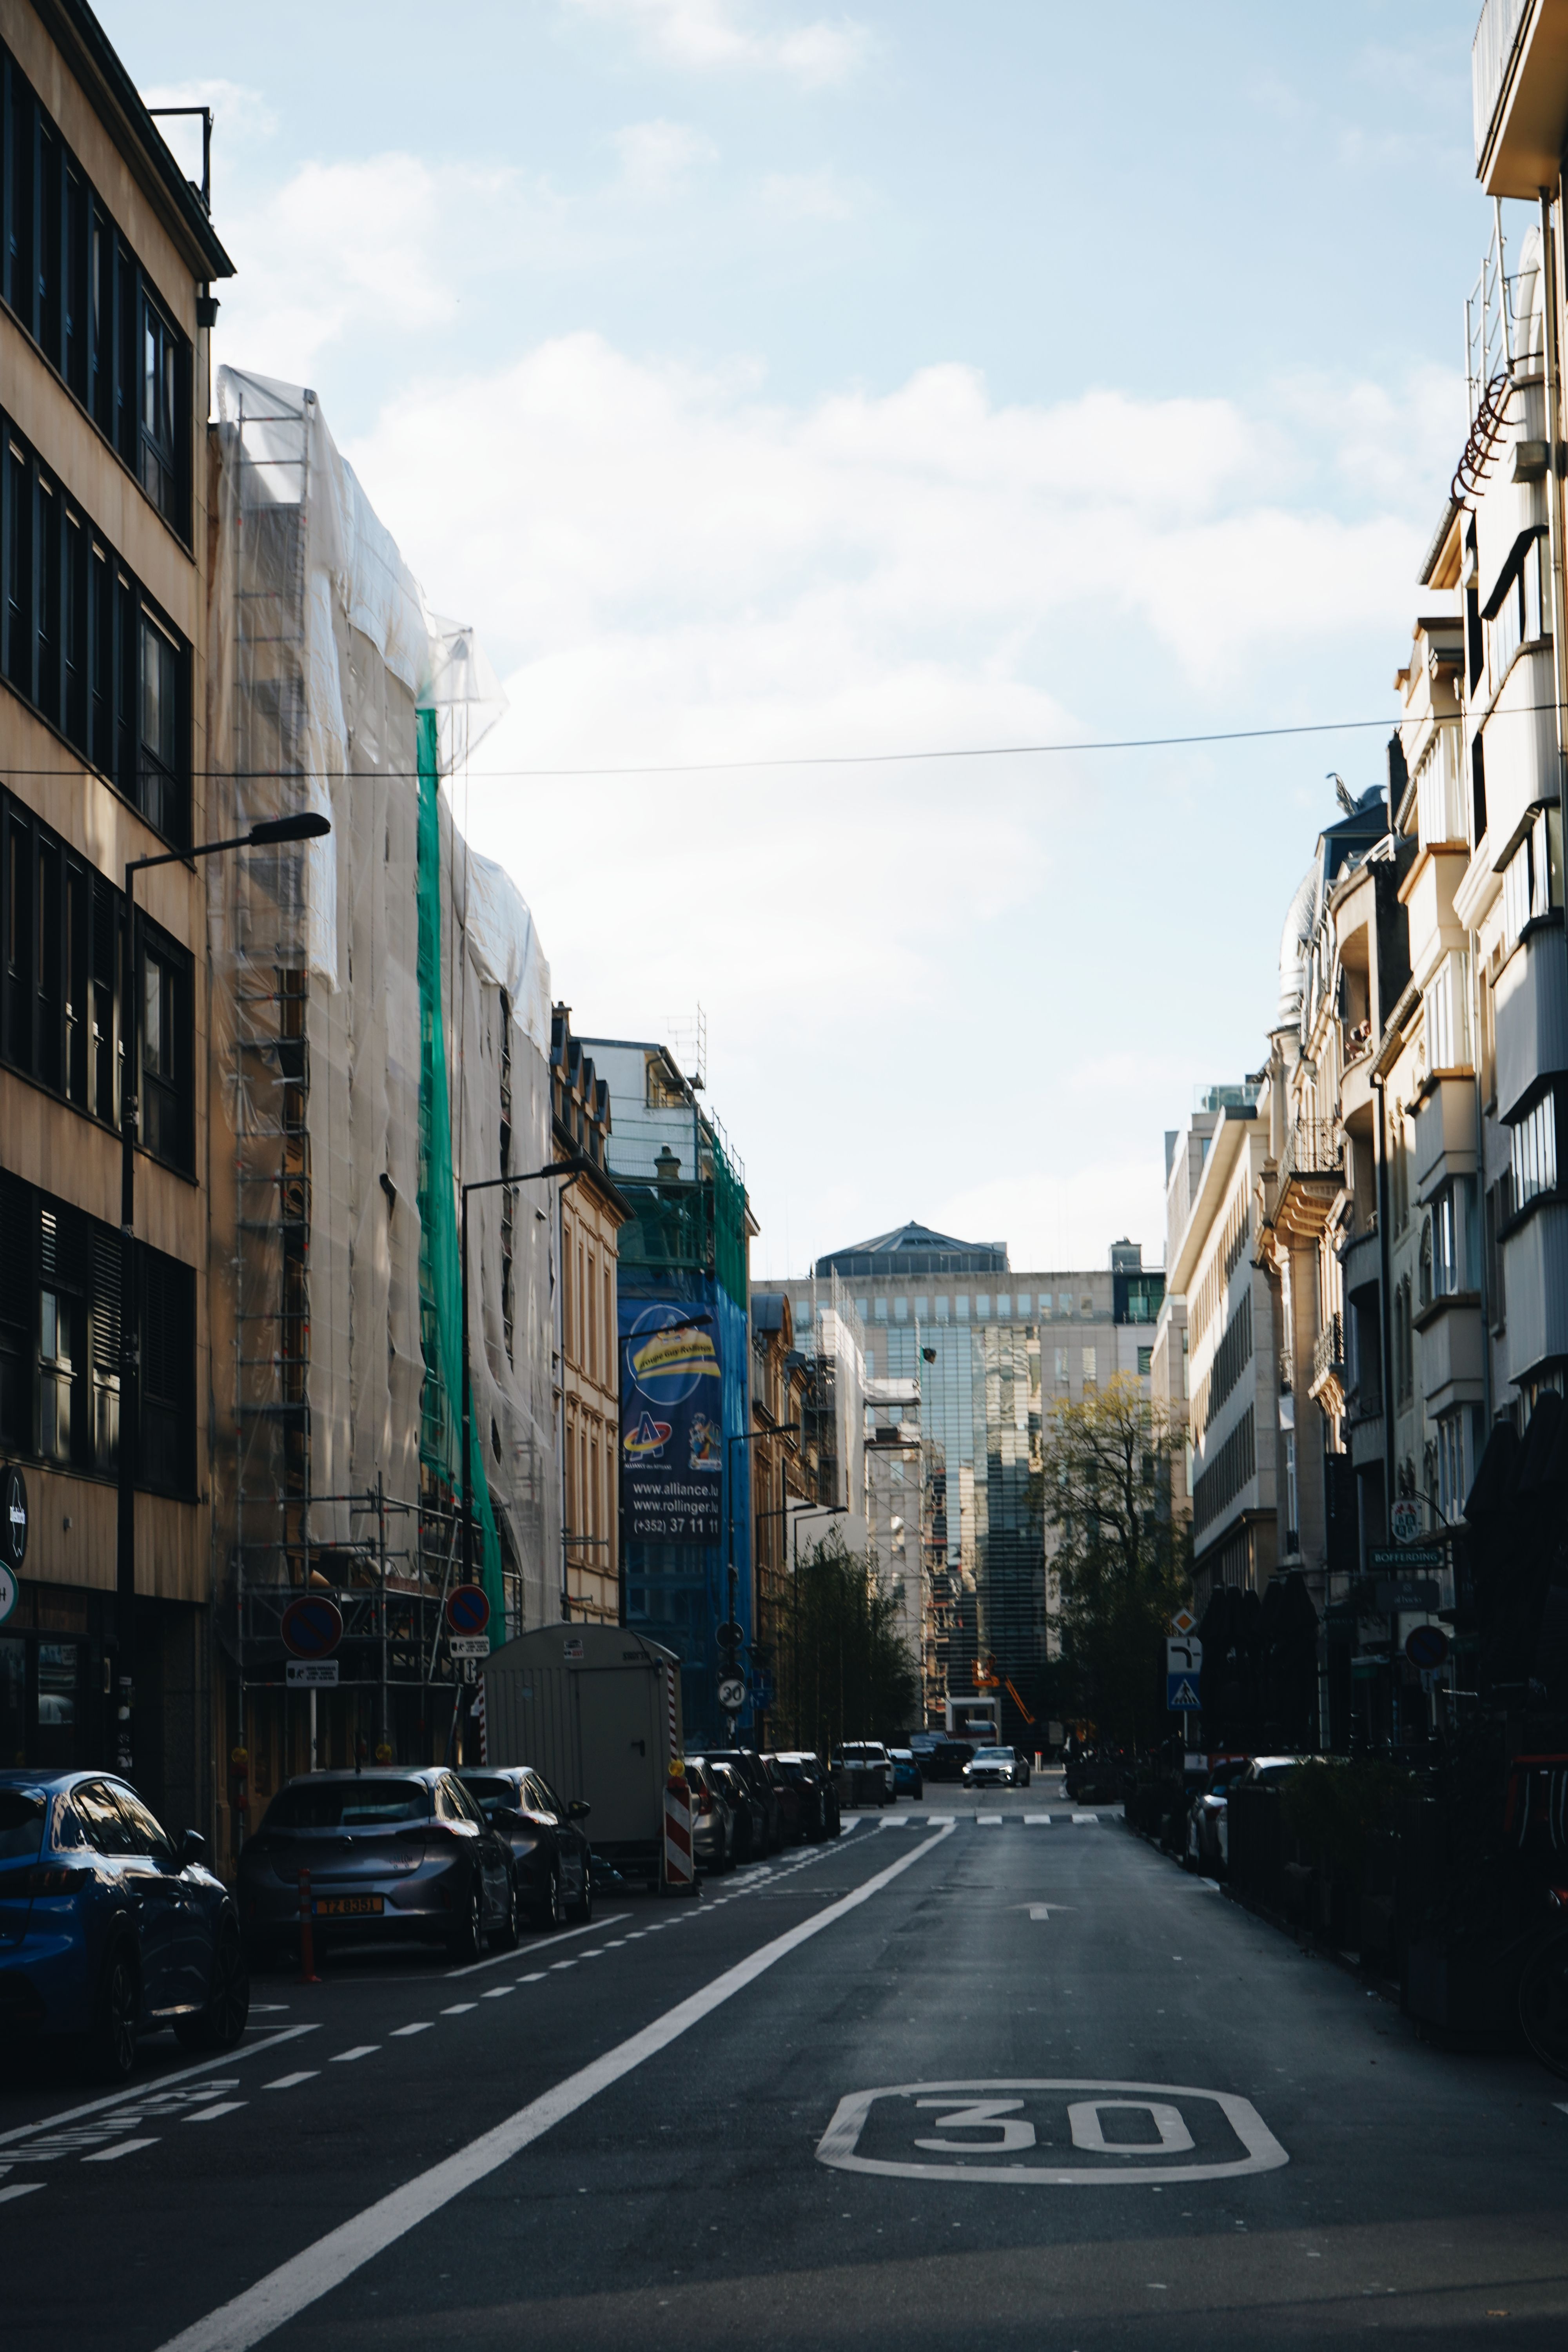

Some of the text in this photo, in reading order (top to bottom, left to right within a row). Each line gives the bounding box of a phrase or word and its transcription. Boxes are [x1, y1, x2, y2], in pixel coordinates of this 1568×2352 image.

[664, 1348, 679, 1358] Guy
[633, 1482, 719, 1497] www.alliance.lu
[633, 1499, 719, 1515] www.rollinger.lu
[633, 1517, 718, 1535] (+352) 37 11 11
[1374, 1552, 1438, 1563] BOFFERDING
[723, 1686, 741, 1701] 30
[325, 1899, 374, 1913] TZ 8351
[914, 2098, 1196, 2154] 30
